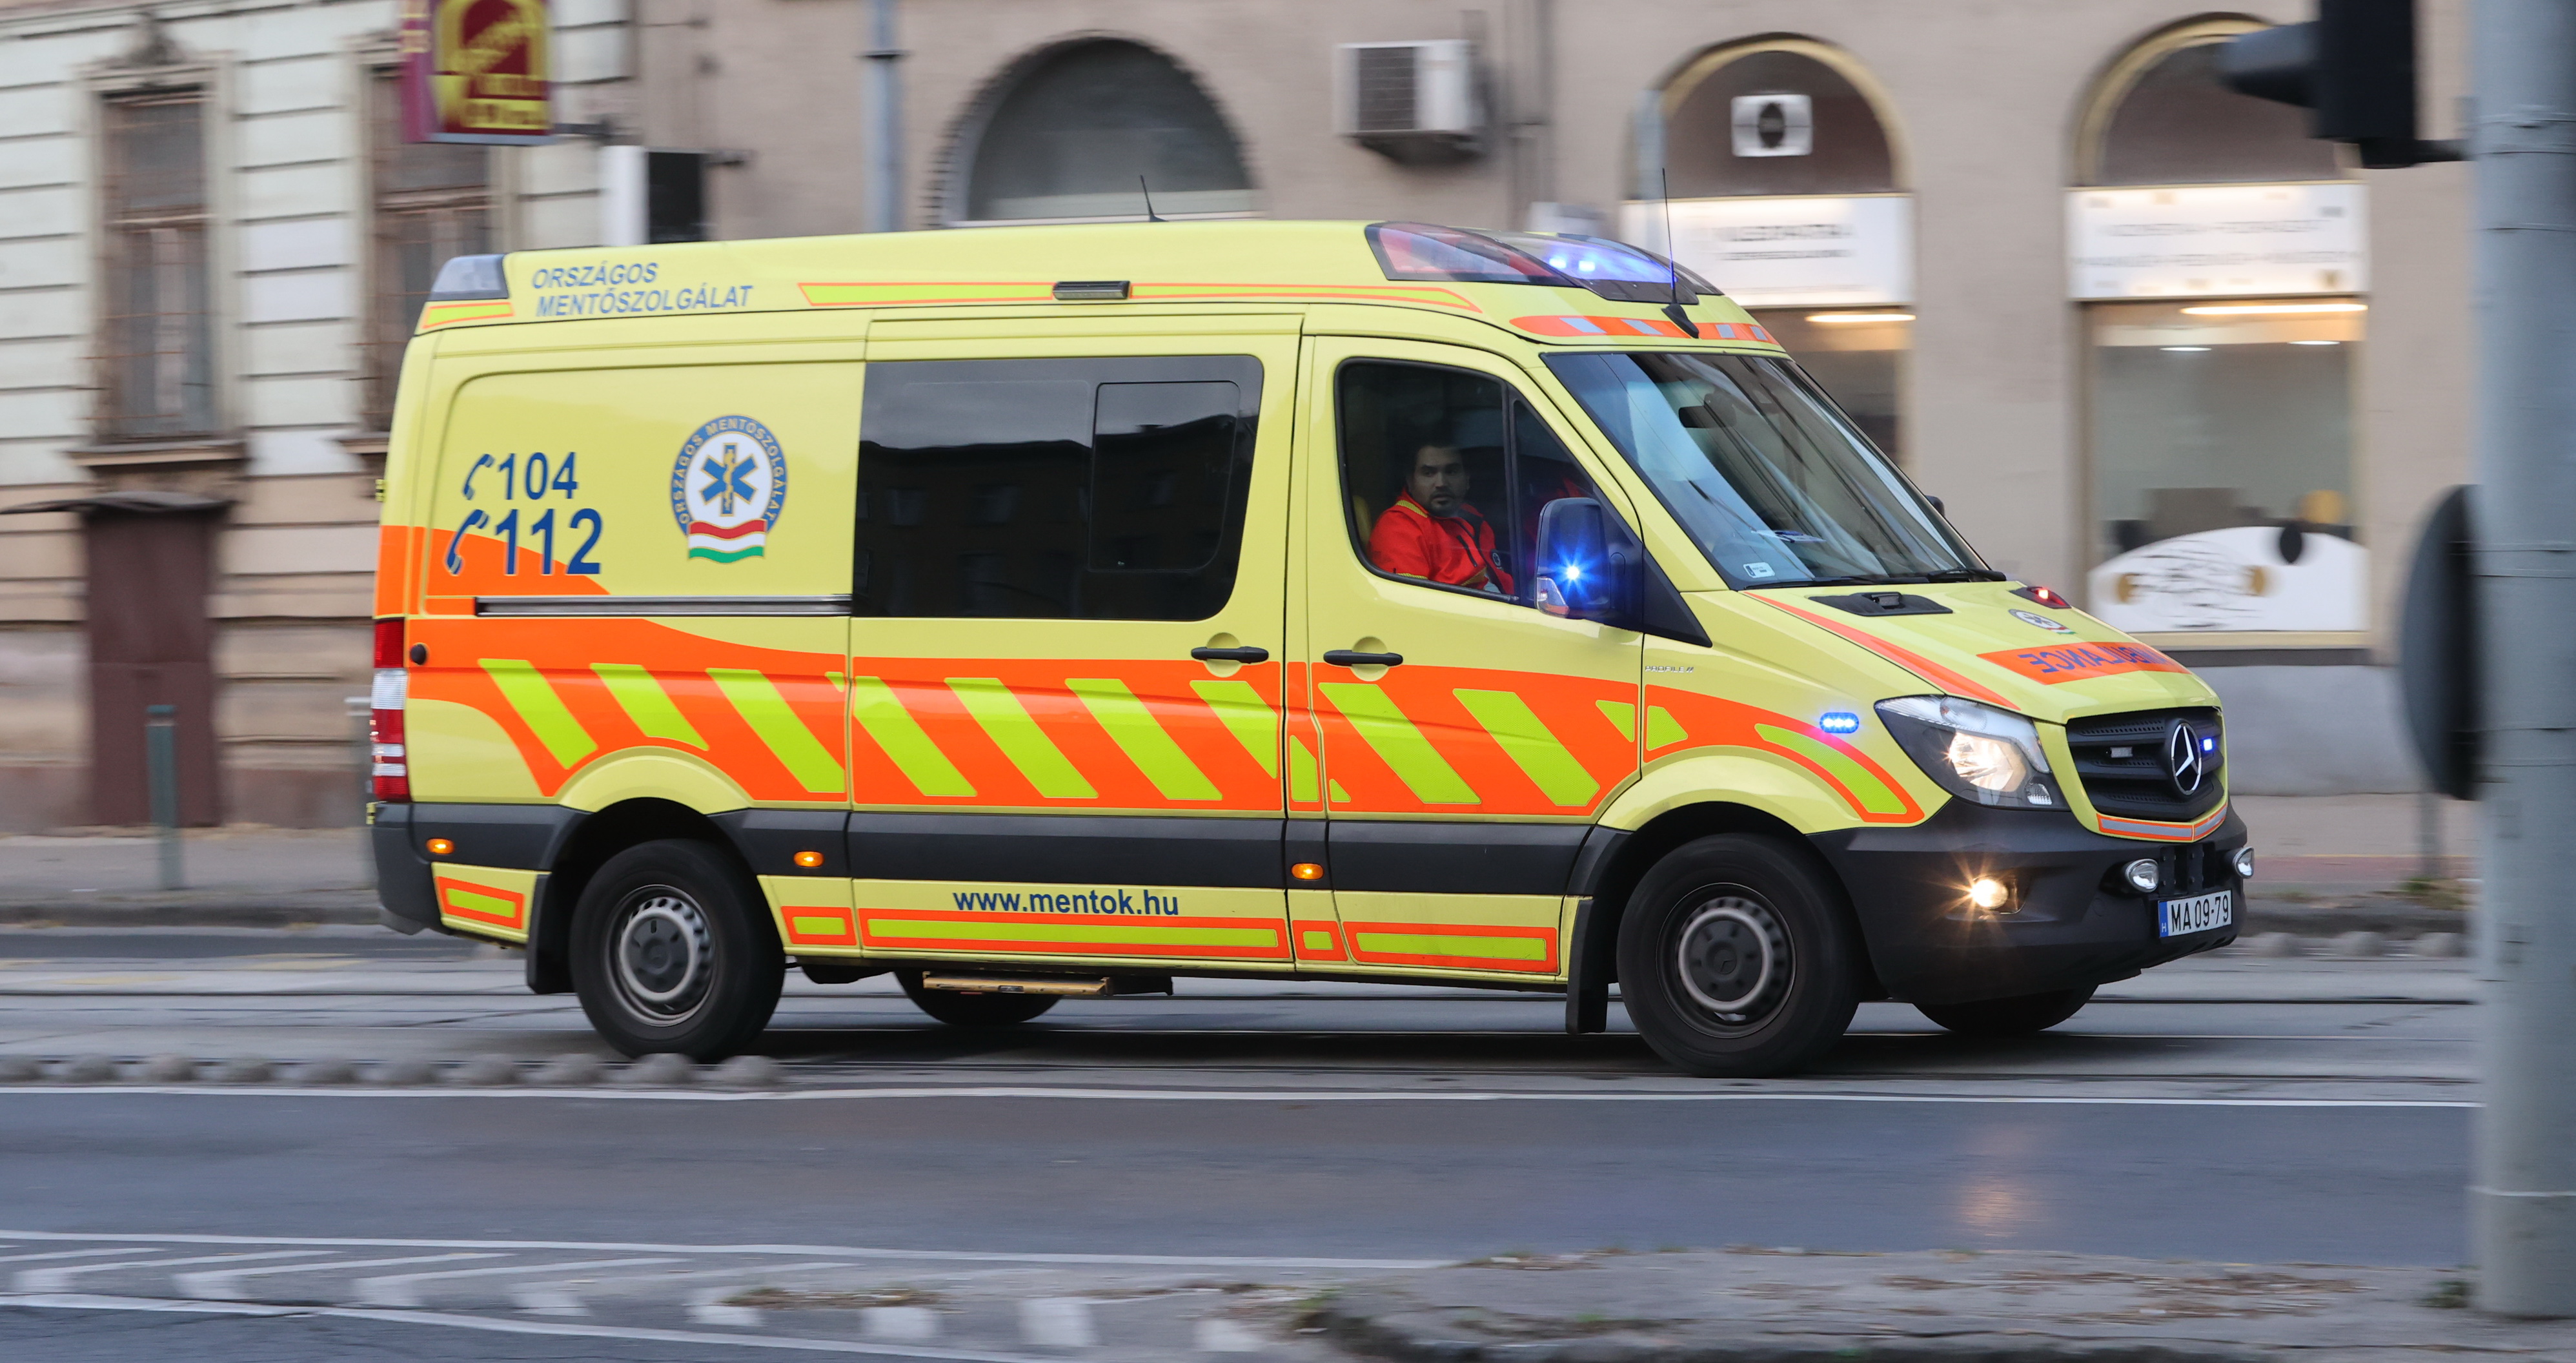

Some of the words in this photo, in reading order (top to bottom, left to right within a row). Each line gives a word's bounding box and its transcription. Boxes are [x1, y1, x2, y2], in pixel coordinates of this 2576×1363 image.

[532, 260, 658, 289] ORSZÁGOS
[535, 282, 753, 316] MENTŐSZOLGÁLAT
[498, 451, 578, 500] 104
[495, 507, 602, 575] 112
[952, 889, 1179, 915] www.mentok.hu
